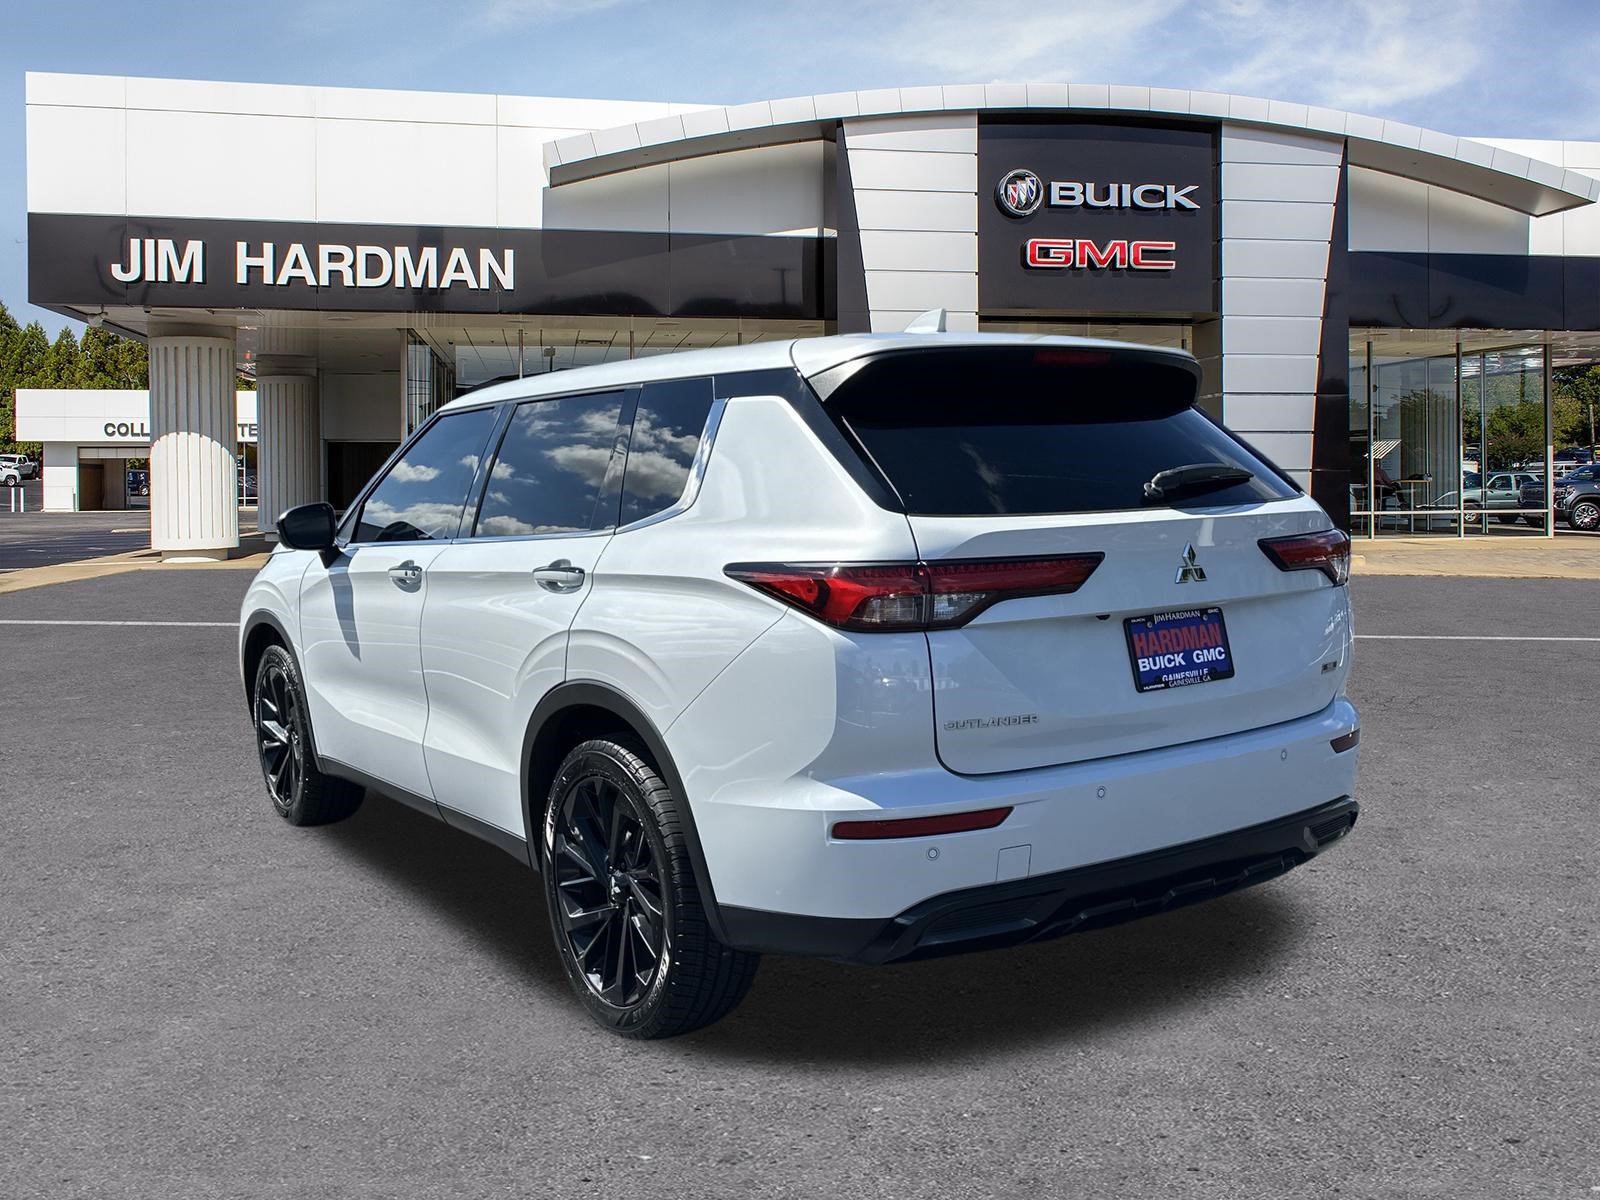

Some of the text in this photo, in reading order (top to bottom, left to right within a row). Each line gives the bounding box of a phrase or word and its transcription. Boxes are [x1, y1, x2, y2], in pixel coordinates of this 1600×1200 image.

[1050, 181, 1200, 209] BUICK
[111, 237, 515, 291] JIM HARDMAN
[1026, 238, 1176, 270] GMC
[104, 422, 150, 437] COLL
[1133, 622, 1223, 657] HARDMAN
[1138, 647, 1225, 672] BUICK GMC
[943, 713, 1040, 731] OUTLANDER
